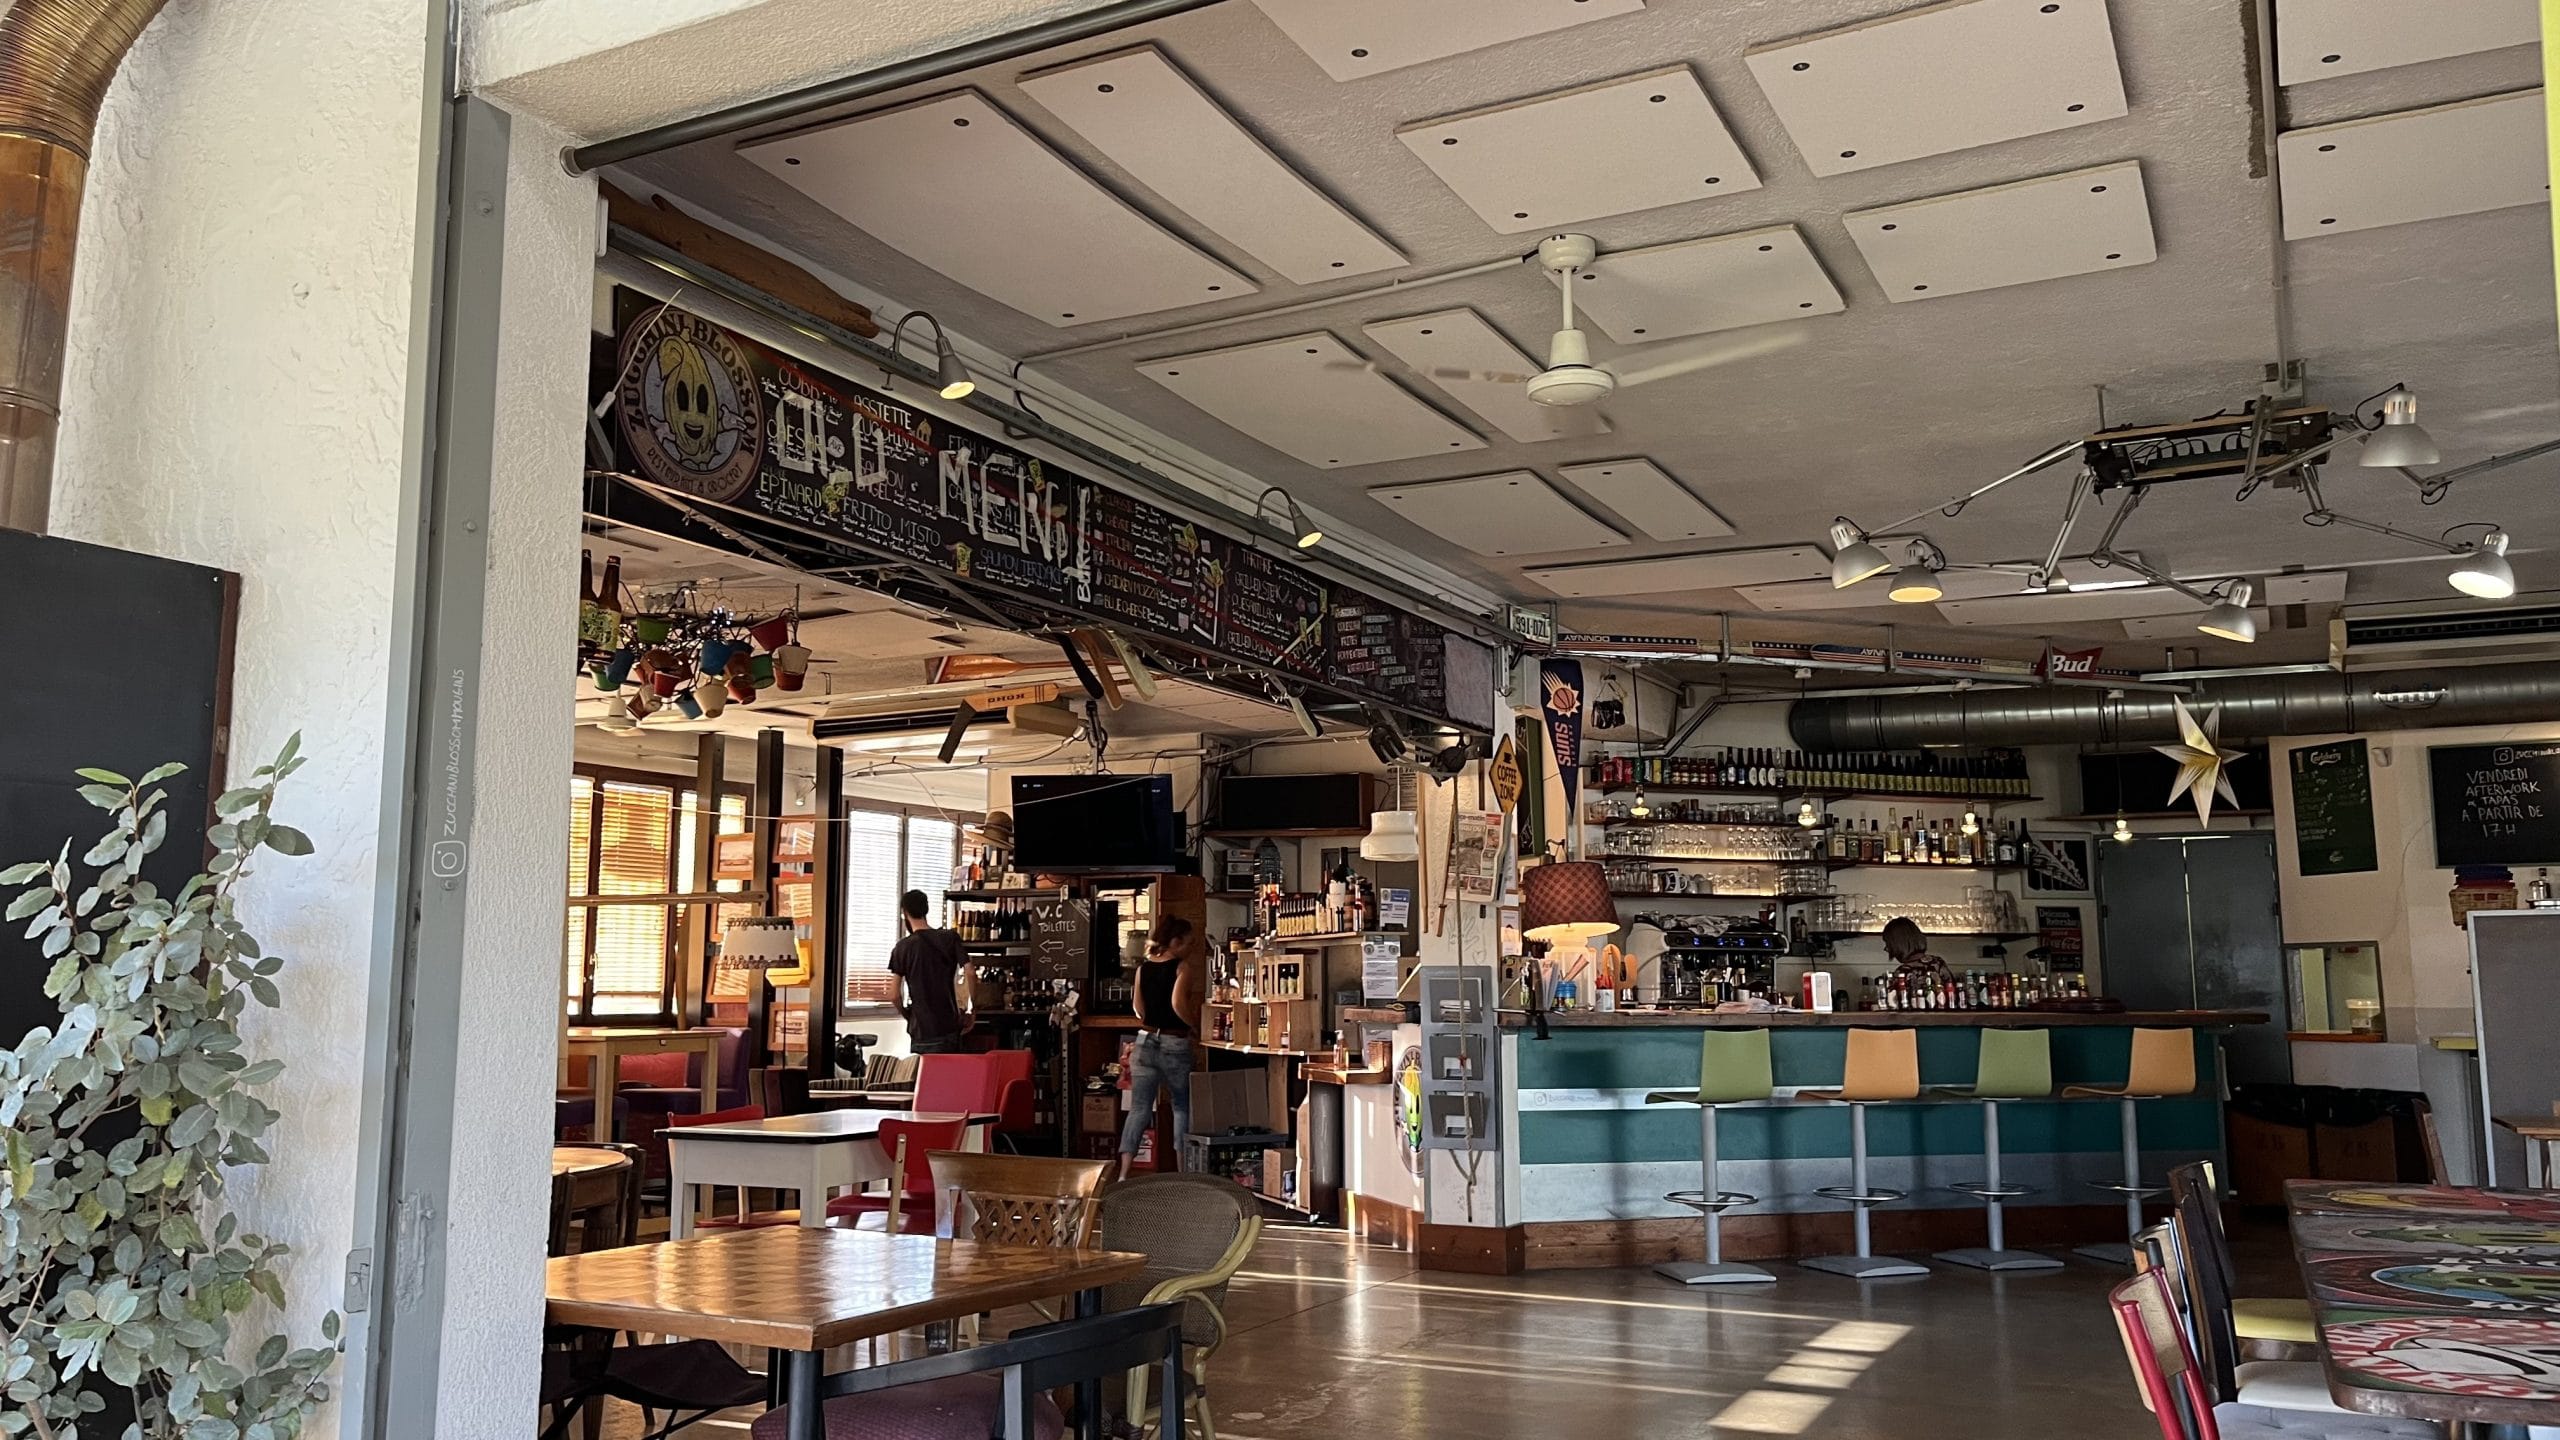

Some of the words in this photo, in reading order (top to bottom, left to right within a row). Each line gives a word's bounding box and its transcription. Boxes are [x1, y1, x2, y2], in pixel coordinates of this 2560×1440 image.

[692, 317, 757, 457] BLOSSOM
[760, 471, 822, 508] EPINARD
[843, 496, 892, 531] FRITTO
[900, 517, 941, 547] MISTO
[1564, 634, 1611, 643] DONNAY
[1860, 648, 1903, 658] DNNAY
[2052, 655, 2094, 673] Bud
[1555, 721, 1571, 767] SUNS
[1497, 765, 1517, 786] COFFEE
[2466, 768, 2528, 784] VENDREDI
[1499, 784, 1514, 801] ZONE
[2465, 781, 2541, 797] AFTERWORK
[2480, 795, 2518, 806] TAPAS
[2462, 809, 2471, 822] A
[2478, 804, 2524, 820] PARTIR
[2528, 805, 2544, 818] DE
[1038, 920, 1076, 934] TOILETTES
